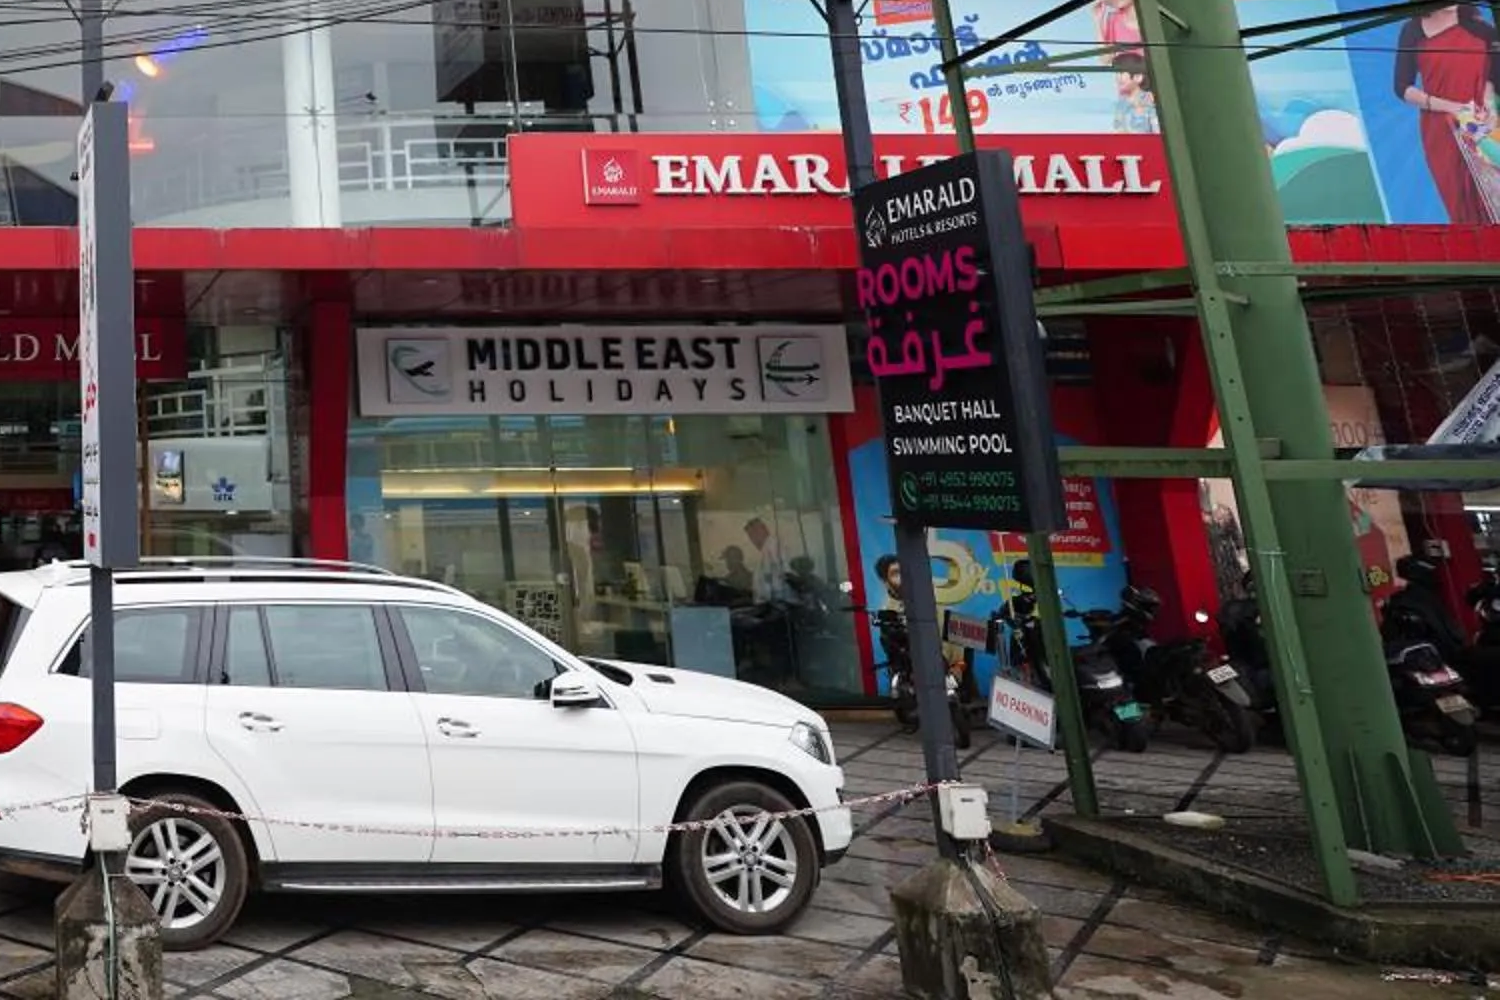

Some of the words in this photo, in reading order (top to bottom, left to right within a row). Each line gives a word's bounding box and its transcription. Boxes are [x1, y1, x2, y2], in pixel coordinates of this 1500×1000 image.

[887, 176, 977, 224] EMARALD
[891, 226, 926, 246] HOTELS
[933, 210, 978, 236] RESORTS
[855, 245, 980, 309] ROOMS
[54, 333, 162, 362] ML
[467, 336, 624, 371] MIDDLE
[635, 337, 740, 371] EAST
[866, 301, 994, 392] غرفة
[467, 378, 747, 403] HOLIDAYS
[893, 401, 959, 424] BANQUET
[960, 399, 1001, 420] HALL
[892, 434, 967, 457] SWIMMING
[968, 432, 1013, 455] POOL
[995, 689, 1009, 708] NO
[1009, 697, 1050, 727] PARKING
